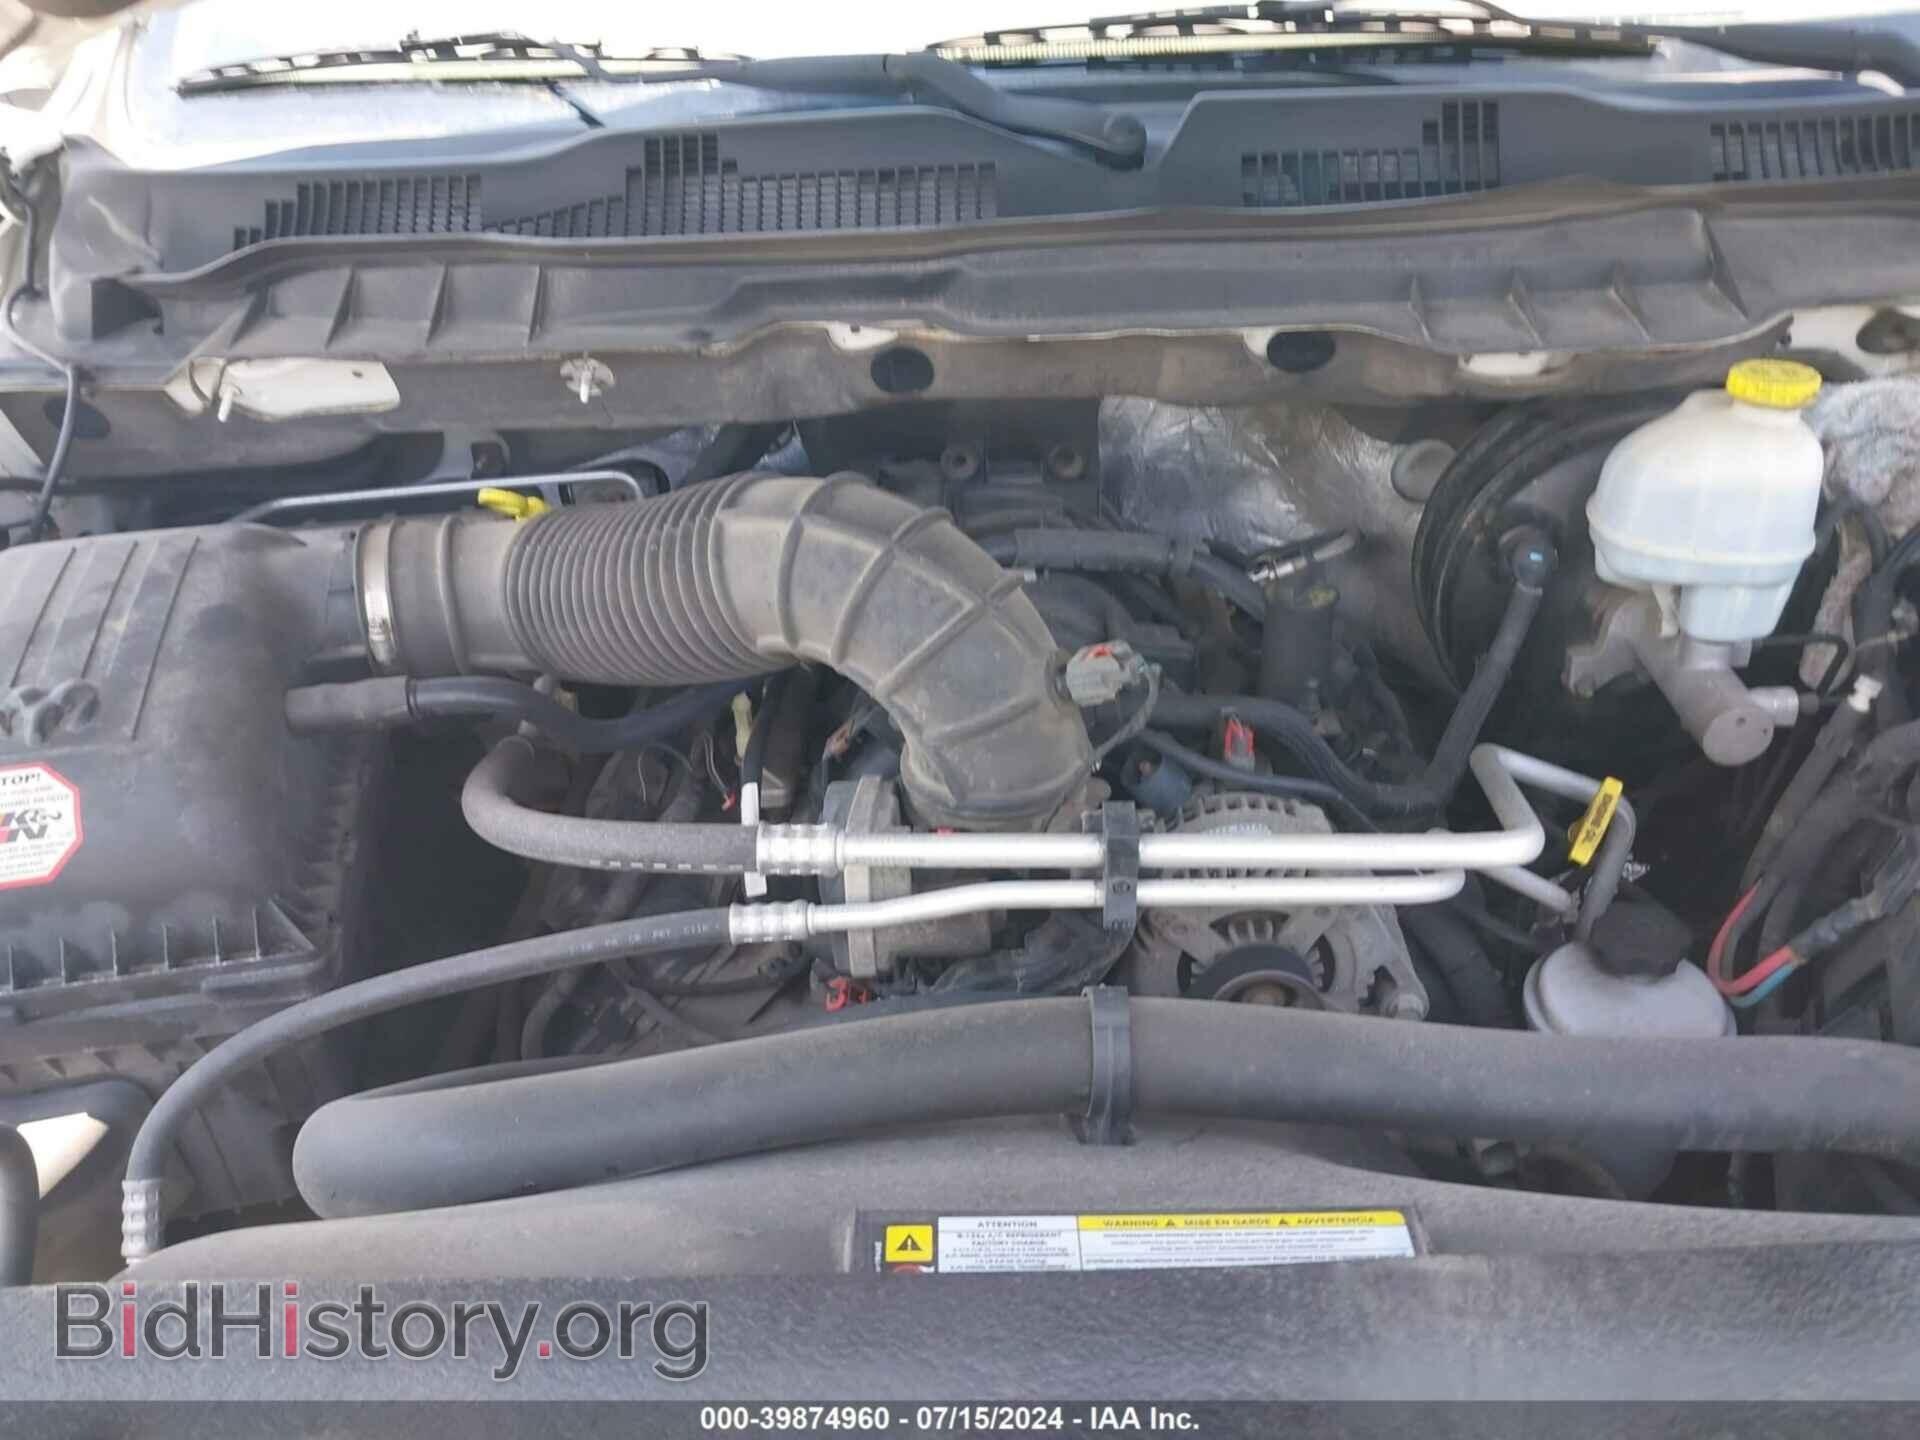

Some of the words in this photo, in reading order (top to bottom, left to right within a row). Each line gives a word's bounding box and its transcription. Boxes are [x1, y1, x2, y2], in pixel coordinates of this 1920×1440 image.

[977, 1219, 1037, 1228] ATTENTION
[1102, 1218, 1159, 1227] WARNING
[1183, 1217, 1211, 1226] MISE
[1214, 1217, 1230, 1226] EN
[1232, 1216, 1269, 1226] GARDE
[1296, 1215, 1375, 1225] ADVERTENCIA
